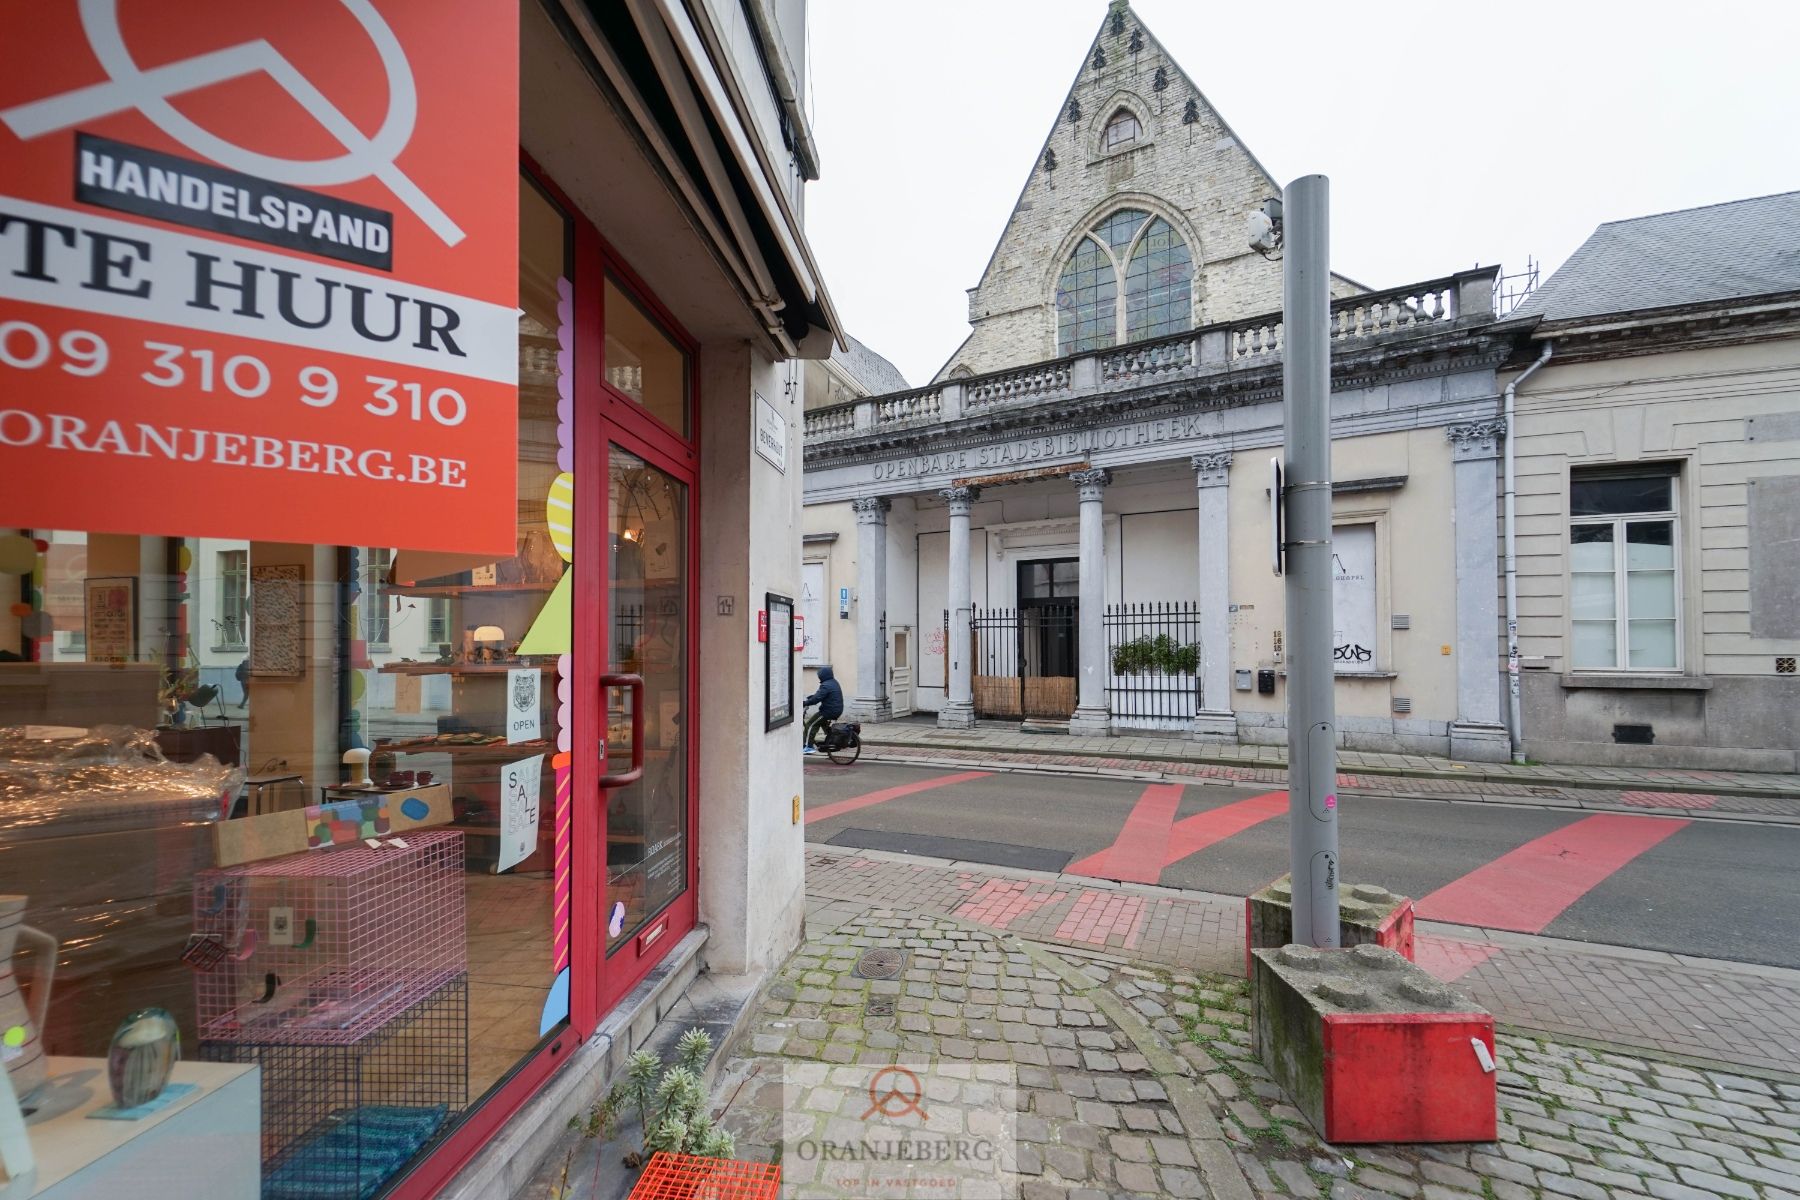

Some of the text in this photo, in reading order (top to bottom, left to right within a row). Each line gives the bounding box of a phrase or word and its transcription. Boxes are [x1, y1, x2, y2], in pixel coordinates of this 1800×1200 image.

[81, 150, 390, 254] HANDELSPAND
[0, 212, 467, 358] TE HUUR
[0, 320, 467, 426] 09 310 9 310
[0, 409, 467, 488] ORANJEBERG.BE
[873, 414, 1201, 480] OPENBARE STADSBIBLIOTHEEK
[513, 719, 535, 731] OPEN
[509, 771, 536, 825] SALE
